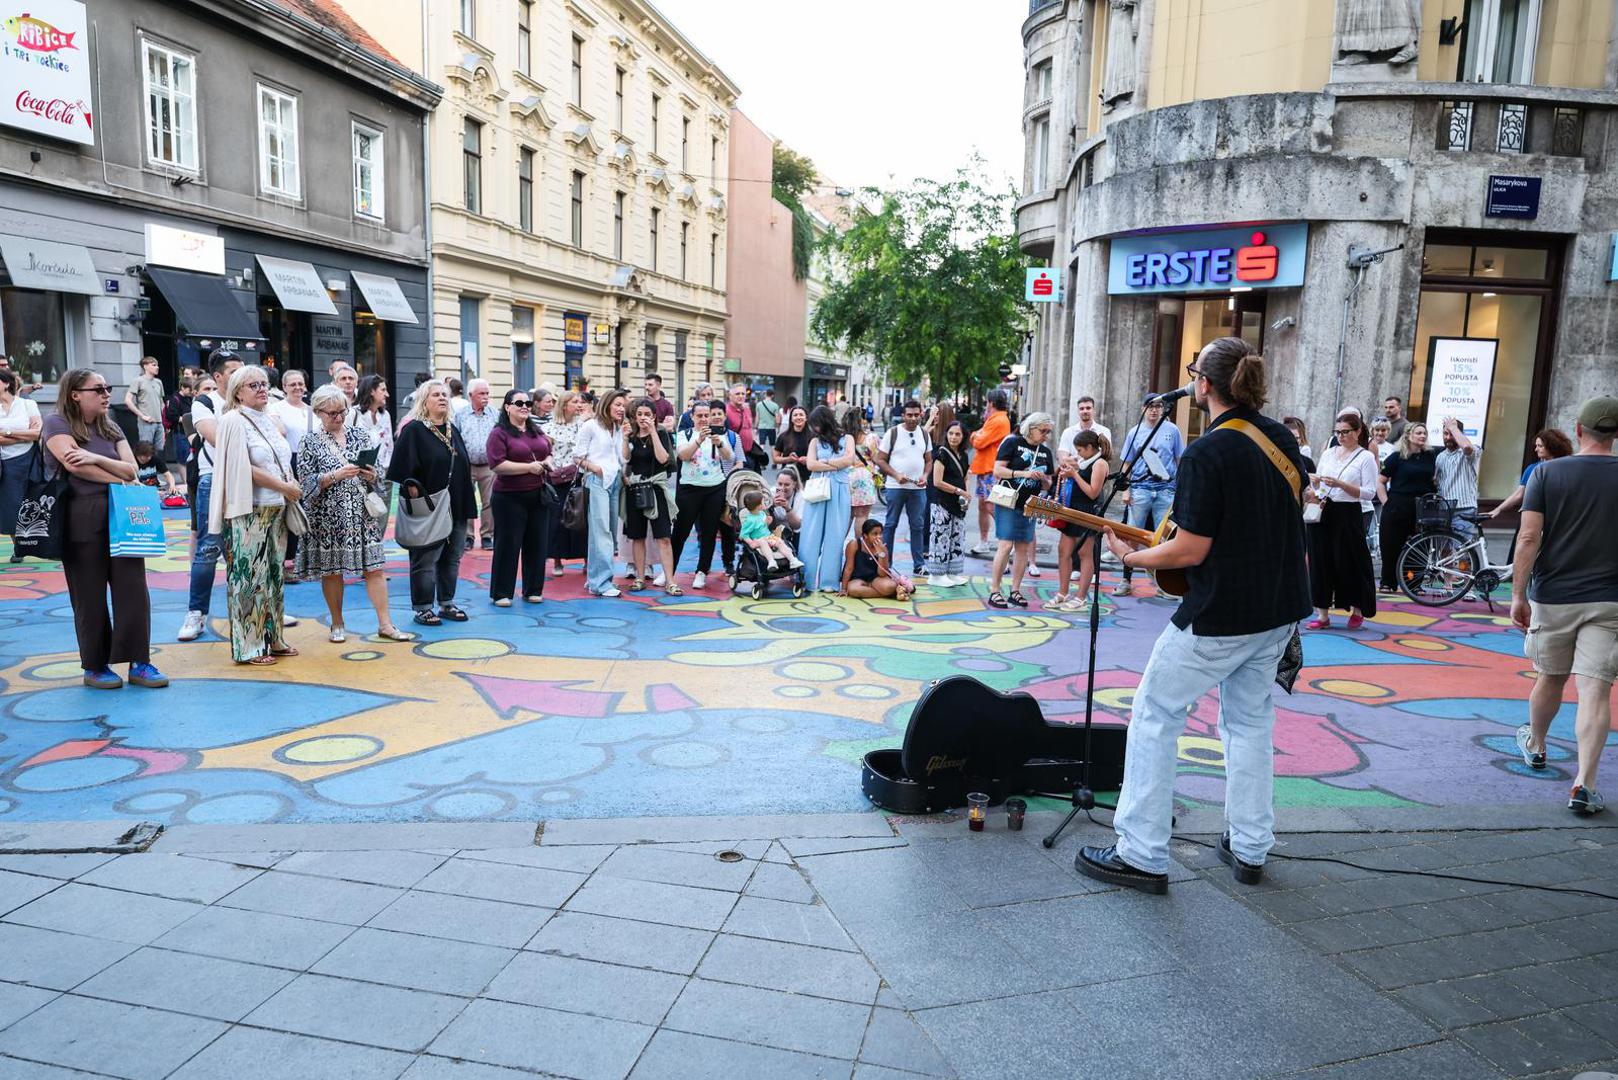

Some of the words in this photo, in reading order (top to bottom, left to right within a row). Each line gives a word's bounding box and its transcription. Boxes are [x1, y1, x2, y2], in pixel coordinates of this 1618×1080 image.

[1494, 179, 1528, 187] Masarykova
[1126, 248, 1233, 286] ERSTE
[316, 325, 343, 336] MARTIN
[317, 338, 350, 350] ARBANAS
[1453, 364, 1473, 373] 15%
[1449, 387, 1470, 396] 10%
